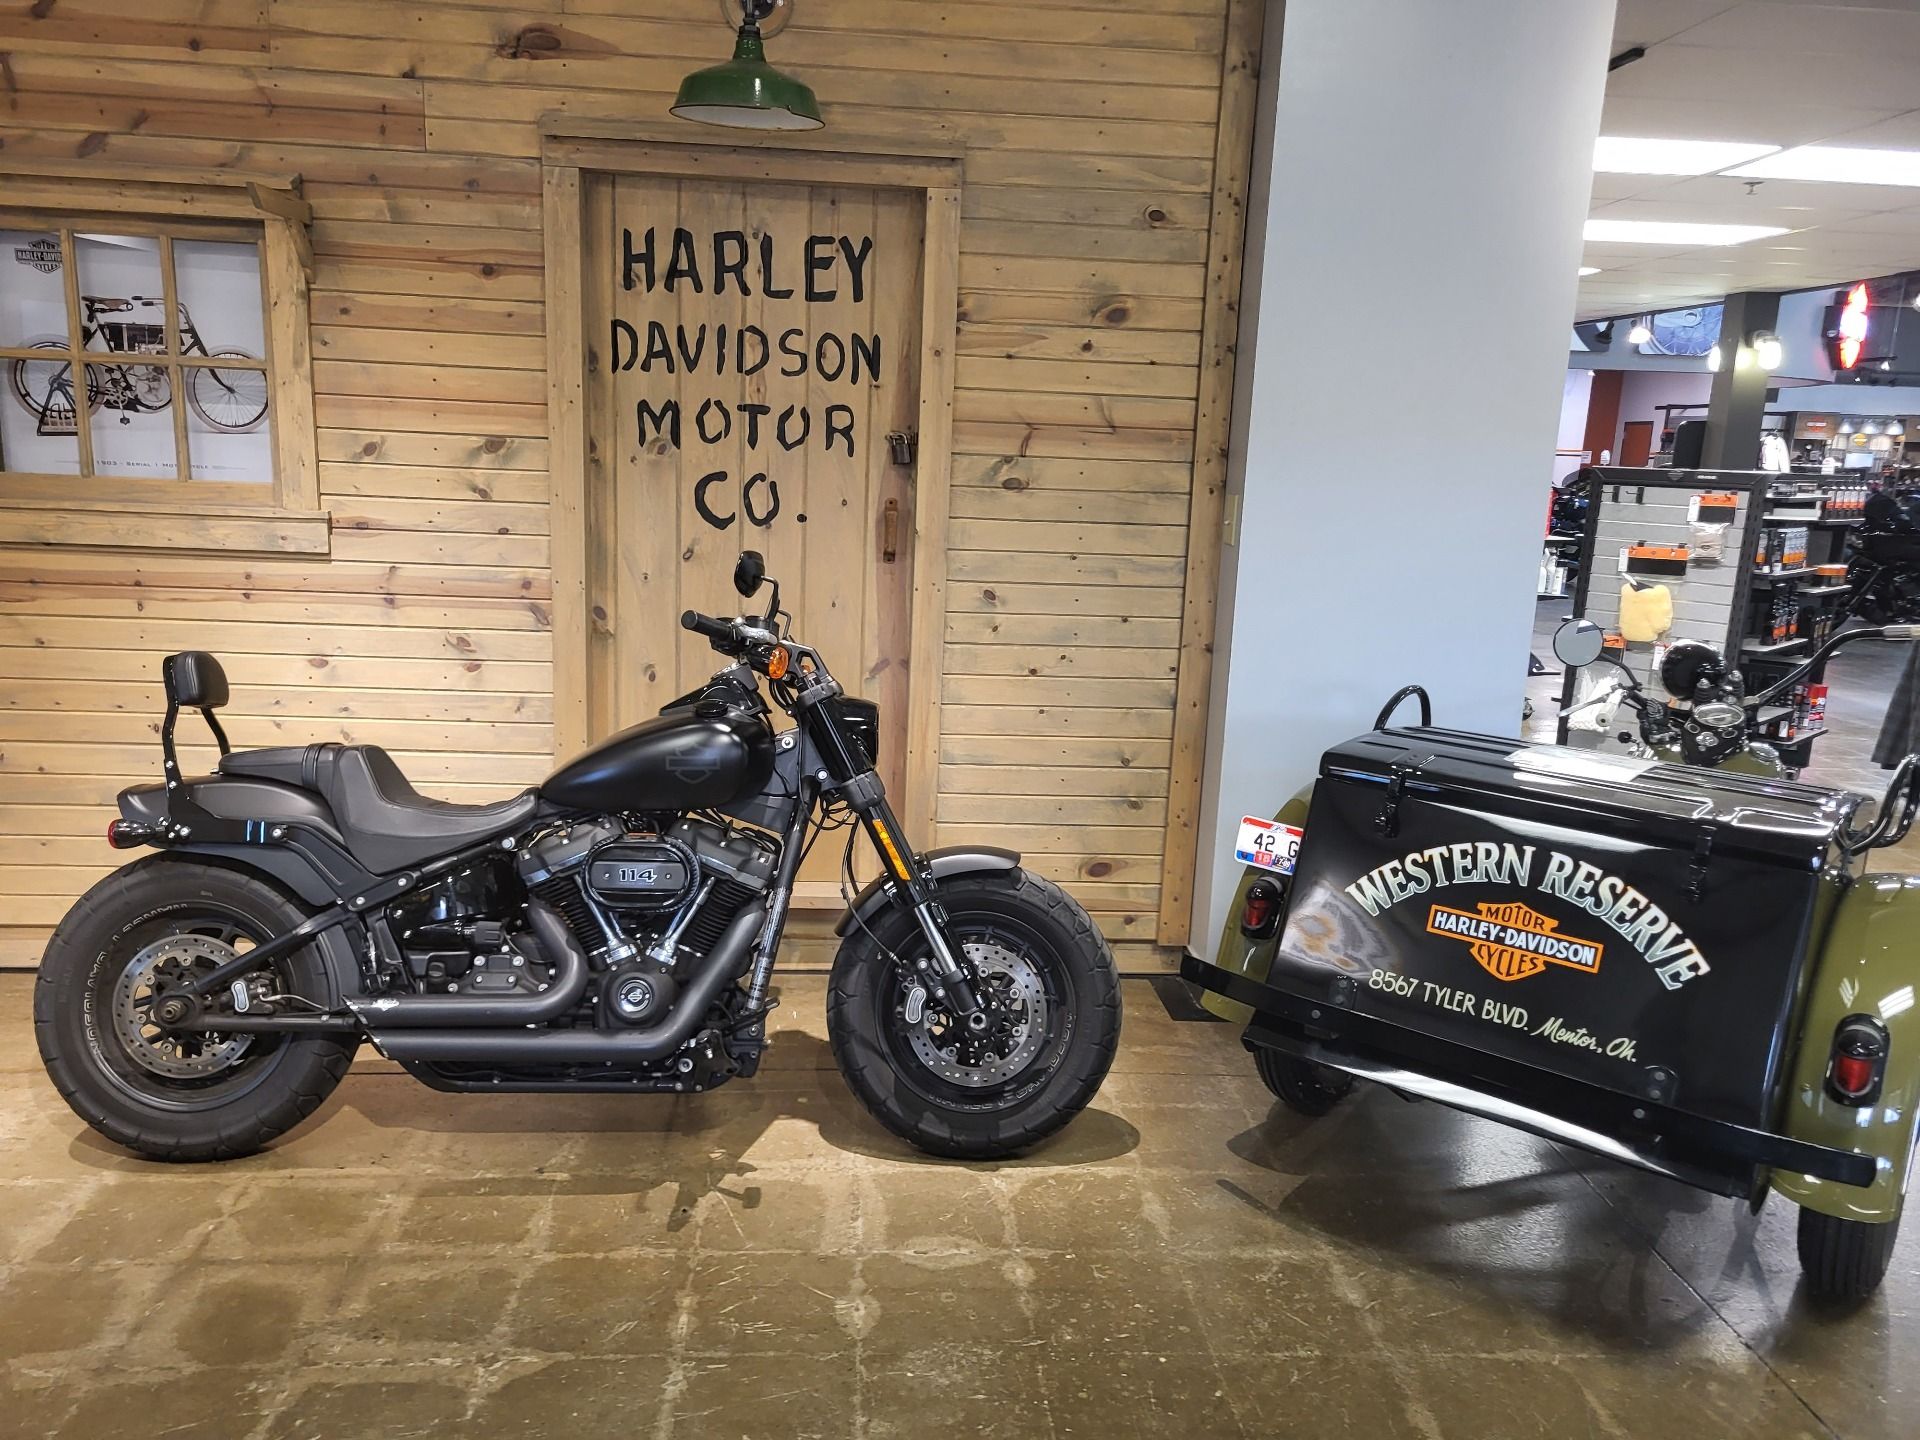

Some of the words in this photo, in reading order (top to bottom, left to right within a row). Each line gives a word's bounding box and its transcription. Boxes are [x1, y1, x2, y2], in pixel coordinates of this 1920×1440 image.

[17, 250, 62, 261] HARLEY-DAVID
[622, 227, 873, 303] HARLEY
[611, 319, 881, 385] DAVIDSON
[636, 398, 855, 458] MOTOR
[694, 471, 808, 530] CO.
[1254, 833, 1275, 853] 42
[619, 869, 657, 882] 114
[1344, 842, 1536, 917] WESTERN
[1537, 851, 1711, 991] RESERVE
[1434, 911, 1596, 966] HARLEY-DAVIDSON
[1485, 905, 1545, 931] MOTOR
[1477, 943, 1540, 977] CYCLES
[1368, 968, 1419, 998] 8567
[1423, 982, 1476, 1016] TYLER
[1481, 999, 1529, 1031] BLVD.
[1530, 1017, 1603, 1054] Mentor,
[1606, 1038, 1637, 1062] Oh.
